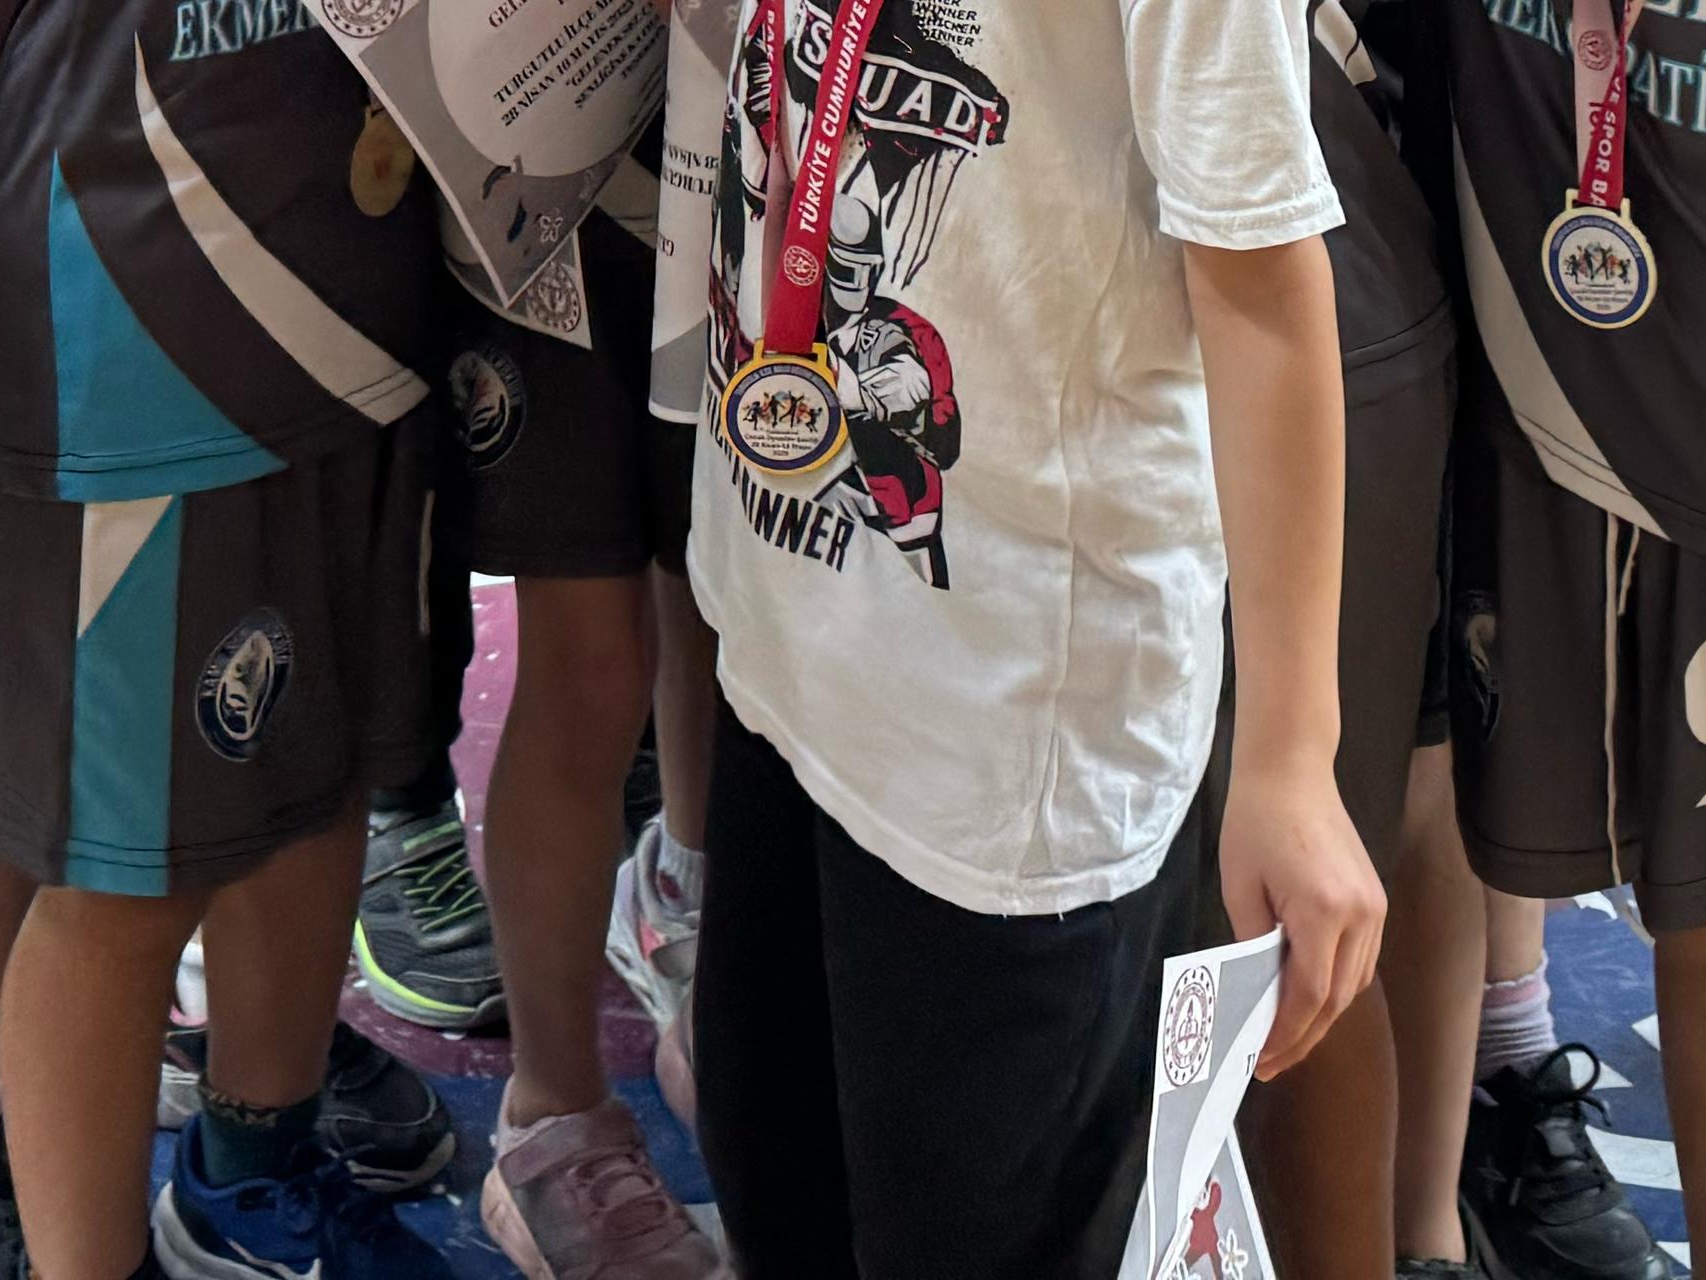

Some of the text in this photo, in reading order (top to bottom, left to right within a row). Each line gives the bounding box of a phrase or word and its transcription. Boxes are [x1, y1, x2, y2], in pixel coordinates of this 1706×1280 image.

[494, 34, 566, 105] TURGUTLU
[803, 17, 977, 135] SUAD
[798, 134, 834, 235] TÜRKİYE
[1595, 109, 1617, 174] SPOR
